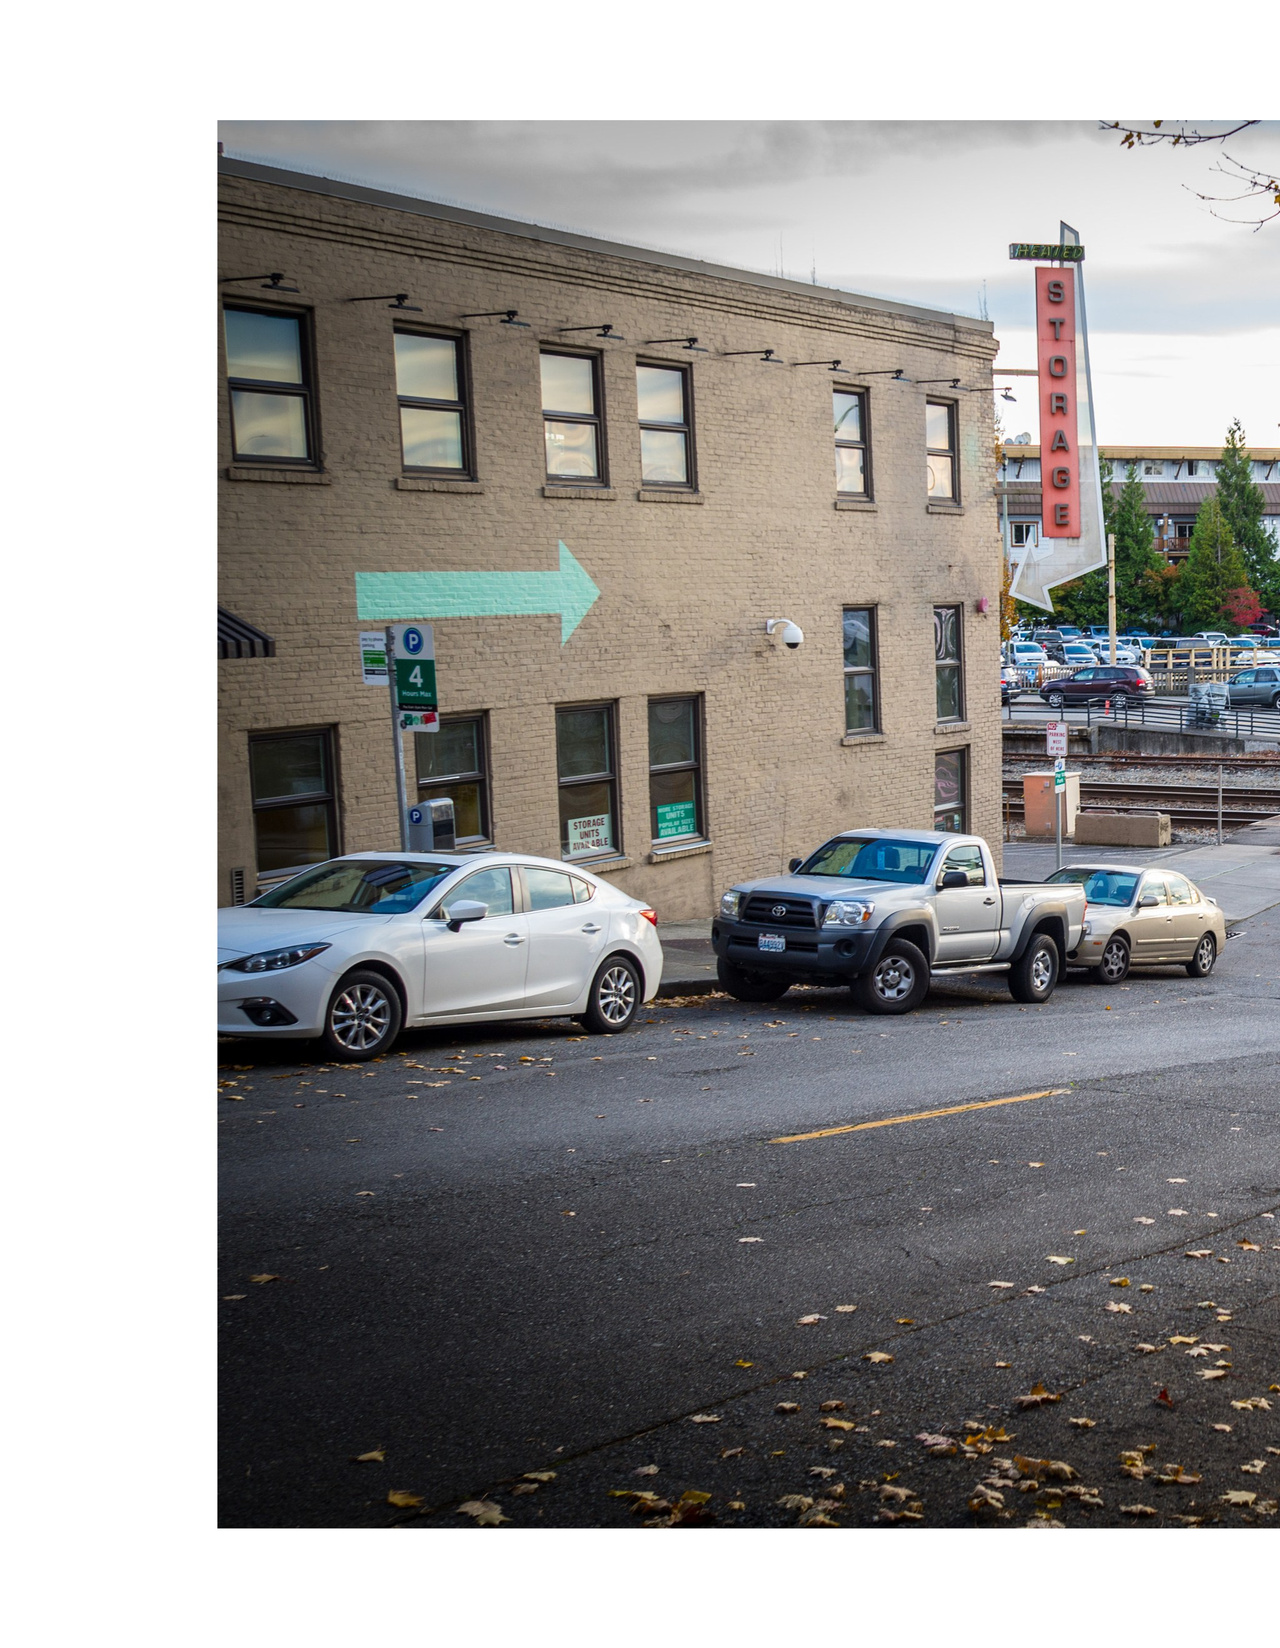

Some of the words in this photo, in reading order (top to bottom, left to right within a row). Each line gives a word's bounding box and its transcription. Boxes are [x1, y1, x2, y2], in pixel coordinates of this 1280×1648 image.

[1015, 245, 1083, 259] HEATED
[1047, 280, 1070, 525] STORAGE
[409, 633, 419, 649] P
[409, 665, 423, 688] 4
[412, 811, 420, 821] P
[666, 810, 685, 819] UNITS
[573, 817, 605, 830] STORAGE
[660, 824, 694, 836] AVAILABLE
[579, 829, 600, 840] UNITS
[573, 837, 608, 851] AVAILABLE
